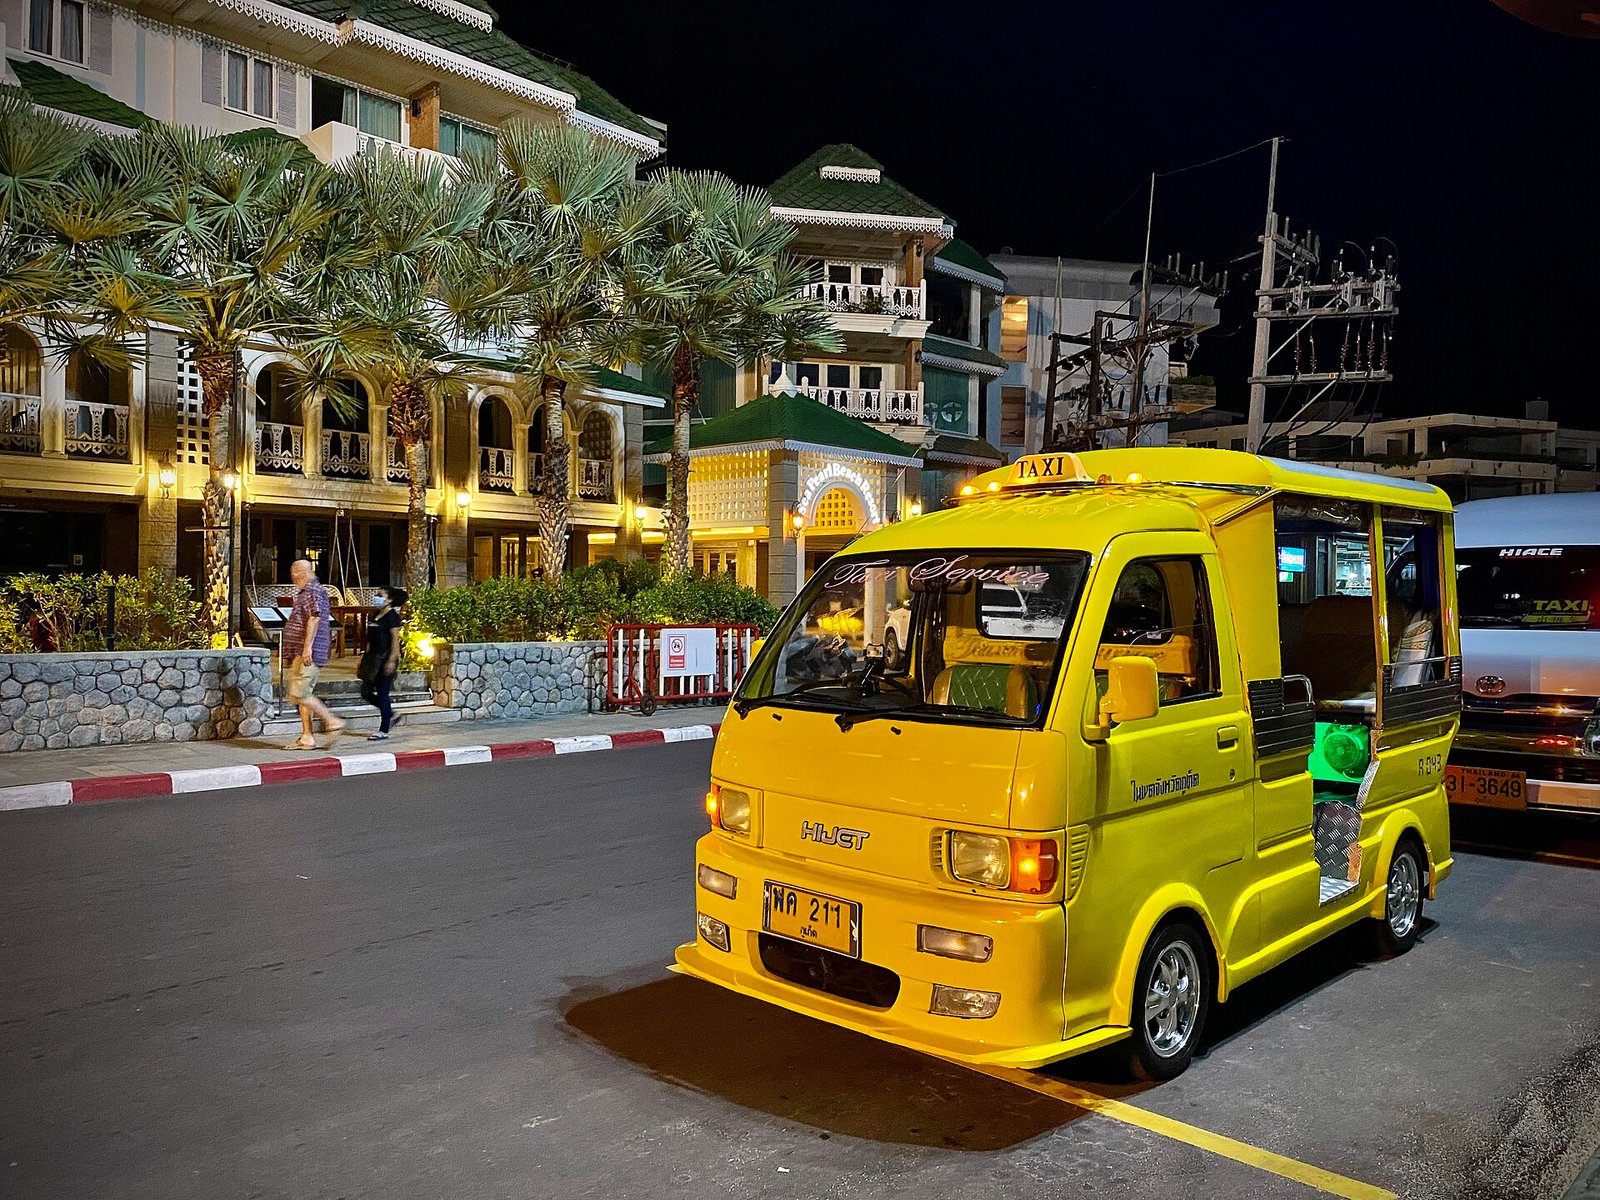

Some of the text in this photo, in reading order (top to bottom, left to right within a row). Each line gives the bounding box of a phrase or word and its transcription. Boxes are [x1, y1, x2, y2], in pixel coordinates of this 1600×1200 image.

[1016, 457, 1064, 479] TAXI
[796, 462, 881, 525] Sea Pearl Beach Resort
[1499, 548, 1563, 556] HIACE
[824, 554, 1050, 589] Taxi Service
[1533, 600, 1589, 611] TAXI
[1460, 767, 1506, 778] THAILAND
[1445, 774, 1521, 799] 31-3649
[801, 820, 870, 850] HIJET
[809, 897, 841, 929] 211
